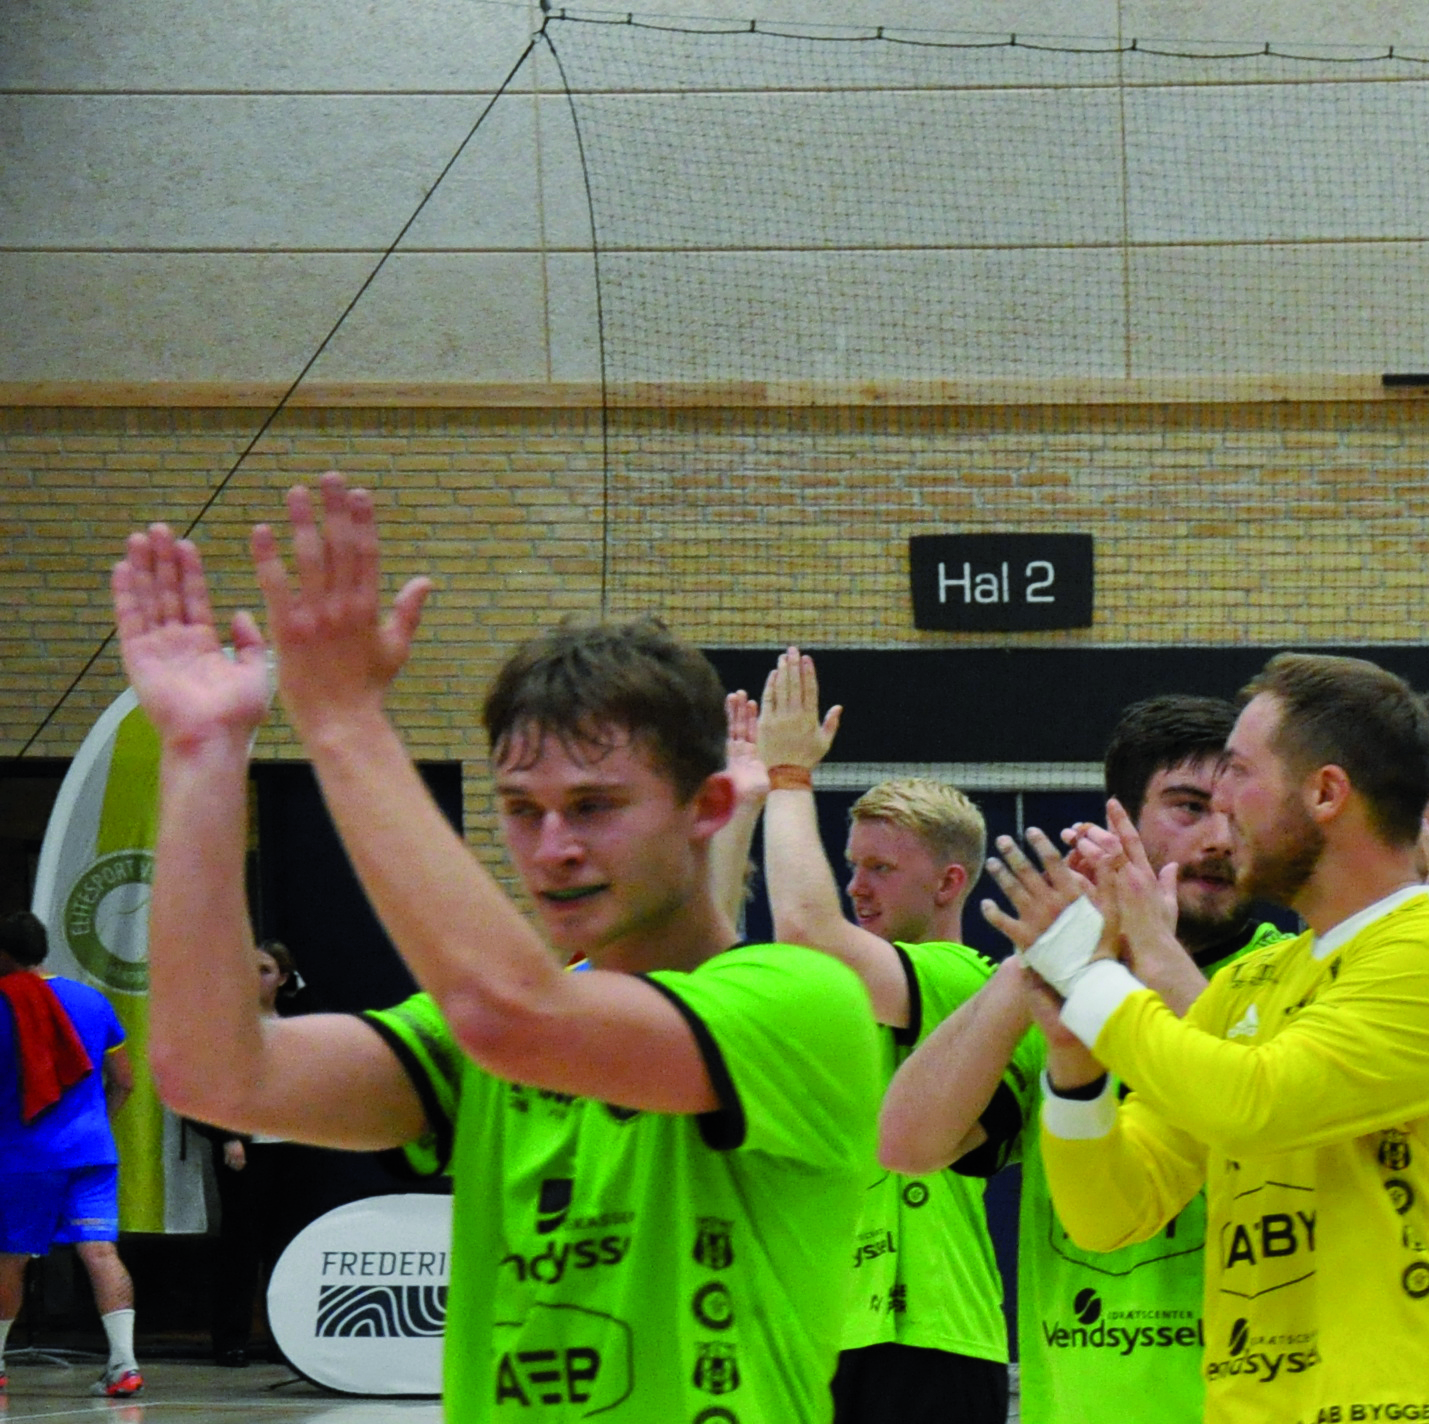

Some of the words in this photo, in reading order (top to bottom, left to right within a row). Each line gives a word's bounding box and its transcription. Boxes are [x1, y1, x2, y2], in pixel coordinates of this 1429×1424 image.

[938, 561, 1009, 604] Hal
[1026, 560, 1055, 603] 2
[323, 1251, 446, 1277] FREDERI
[1042, 1318, 1204, 1356] Vendsyssel
[1316, 1406, 1343, 1424] AB
